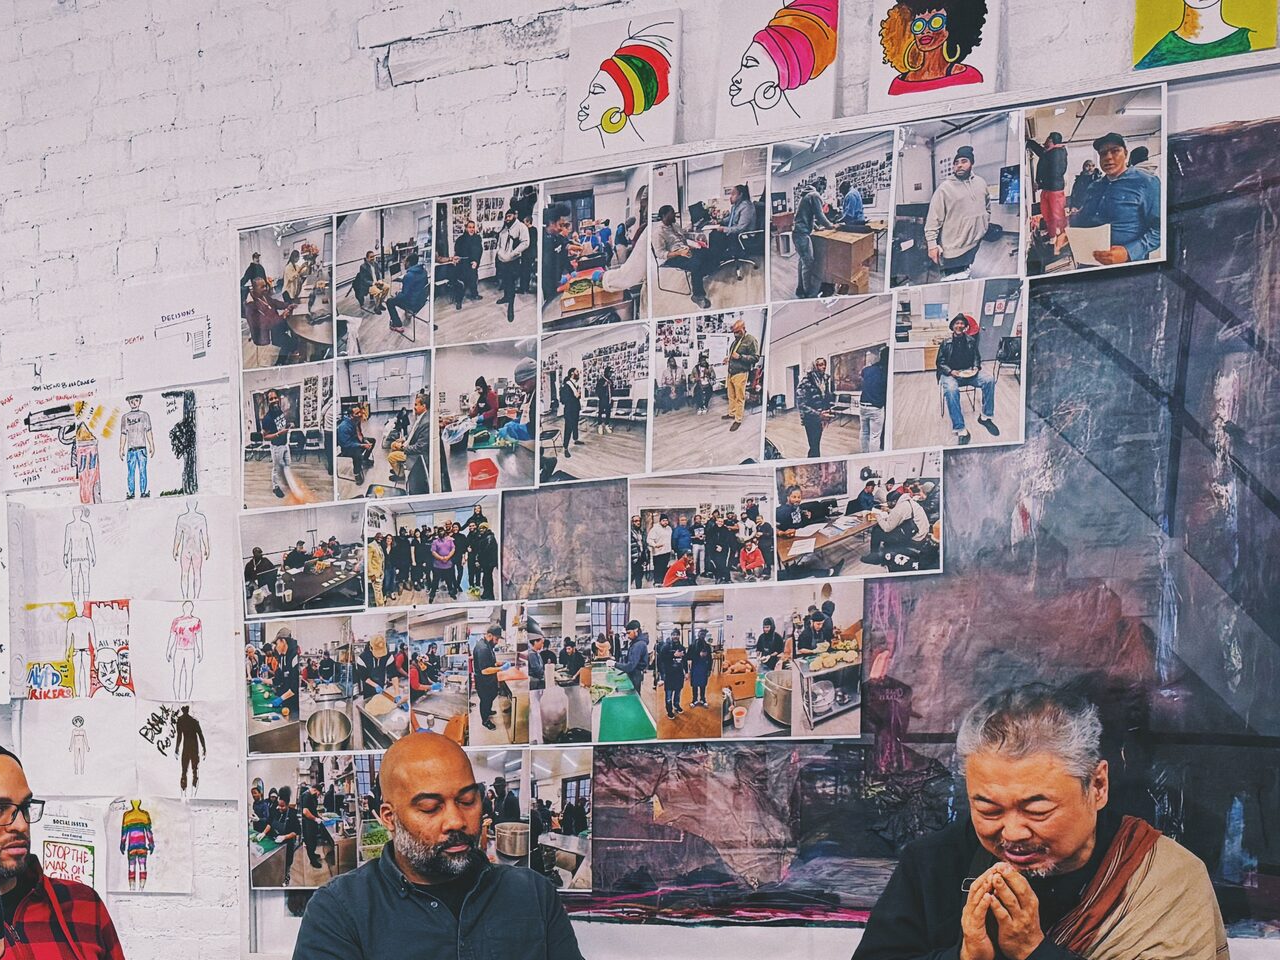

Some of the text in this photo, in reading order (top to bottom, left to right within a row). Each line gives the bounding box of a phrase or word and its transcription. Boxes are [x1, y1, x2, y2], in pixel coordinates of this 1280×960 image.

[161, 308, 195, 322] DECISIONS
[124, 335, 145, 346] DEATH
[45, 842, 89, 863] STOP THE
[45, 860, 85, 875] WAR ON
